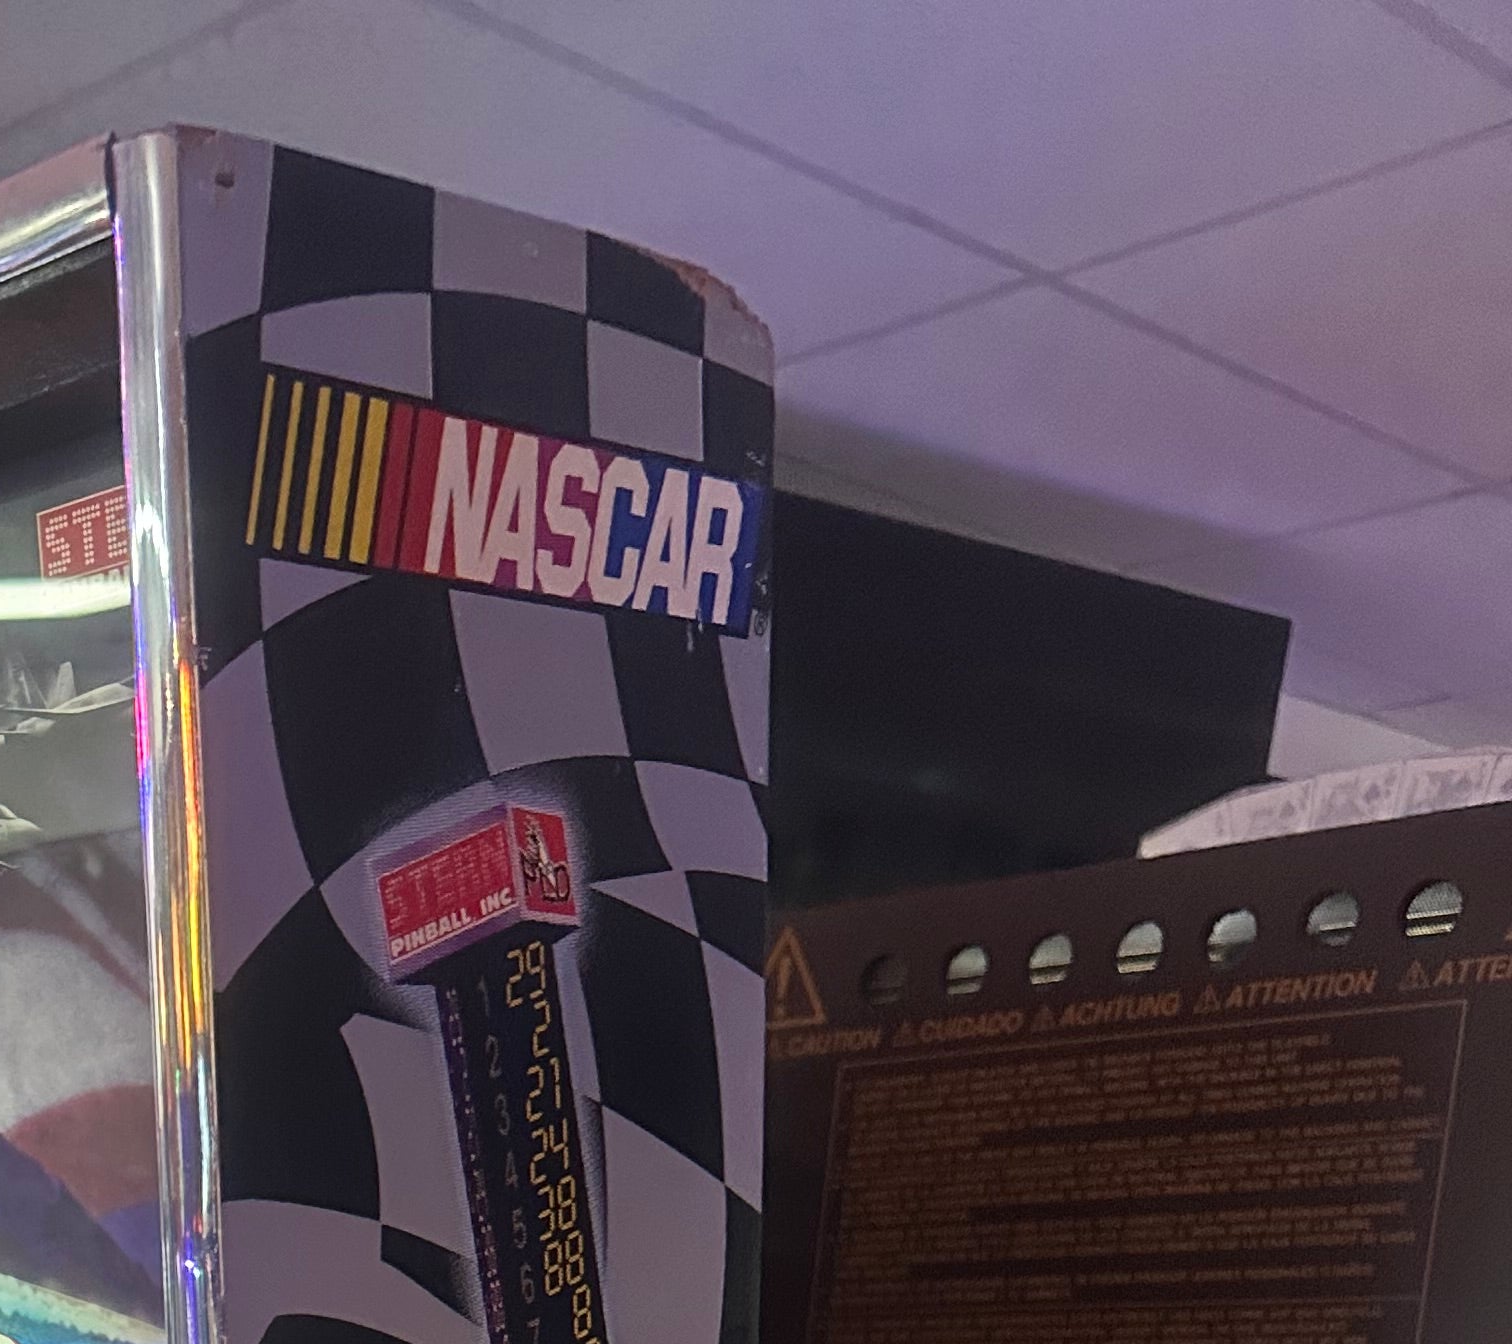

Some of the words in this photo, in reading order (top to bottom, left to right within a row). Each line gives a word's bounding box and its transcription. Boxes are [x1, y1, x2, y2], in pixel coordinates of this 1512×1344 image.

[424, 414, 744, 626] NASCAR
[507, 941, 547, 1007] 29
[1224, 969, 1379, 1009] ATTENTION
[544, 1230, 585, 1296] 88
[572, 1284, 591, 1340] 8
